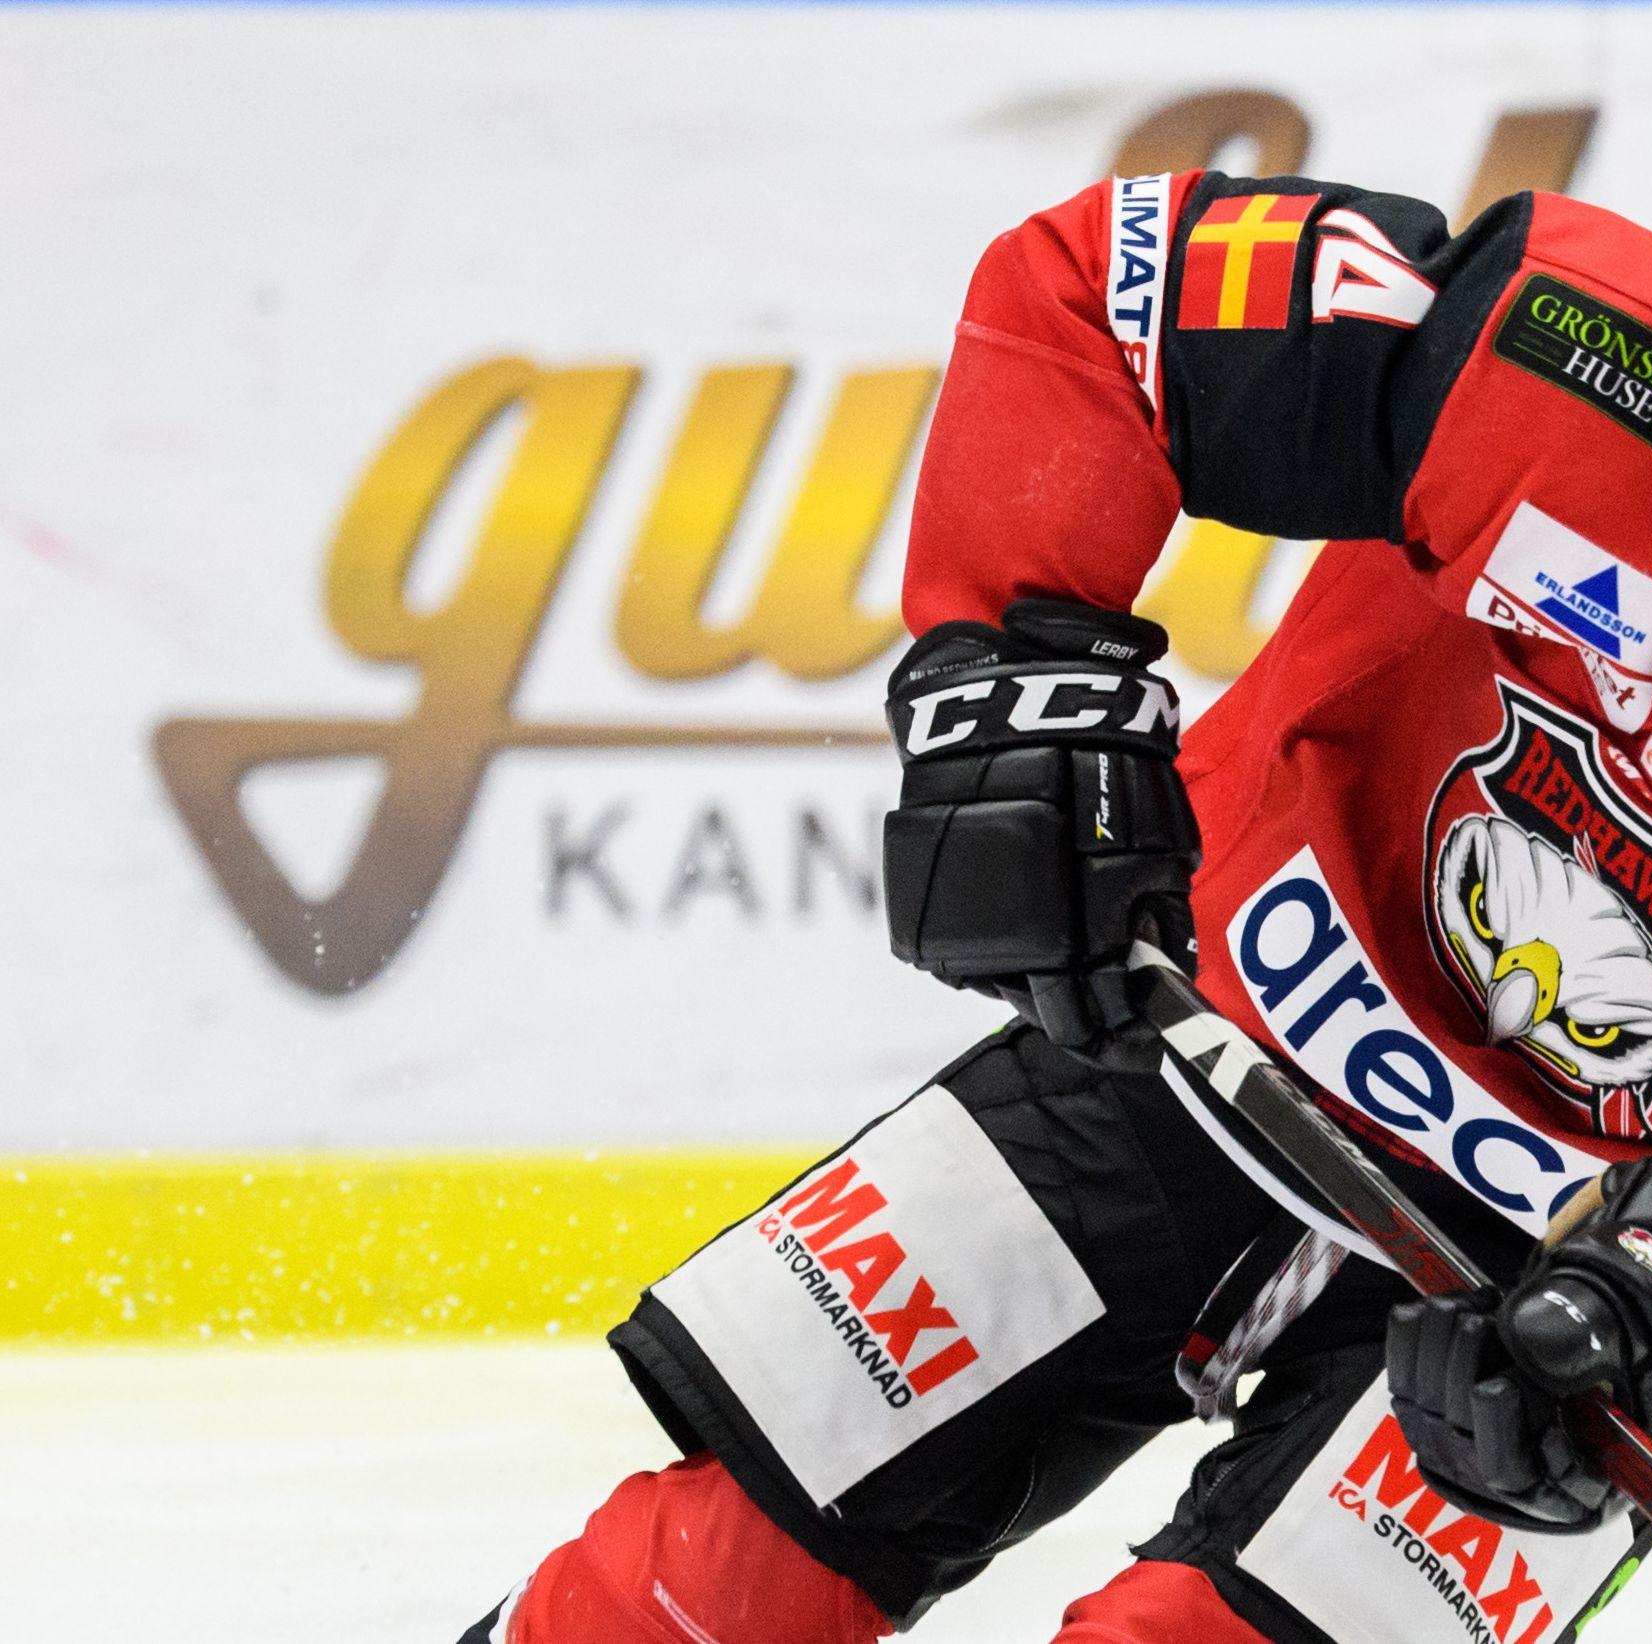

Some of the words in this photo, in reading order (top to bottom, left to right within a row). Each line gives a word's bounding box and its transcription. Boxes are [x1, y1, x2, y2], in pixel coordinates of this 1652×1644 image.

[1090, 639, 1140, 661] LERBY
[1534, 571, 1648, 645] ERLANDSSON
[753, 1212, 778, 1245] ICA
[774, 1232, 913, 1411] STORMARKNAD
[778, 1156, 981, 1398] MAXI
[1328, 1481, 1367, 1524] ICA
[1373, 1513, 1498, 1644] STORMARK
[1342, 1413, 1554, 1644] MAXI
